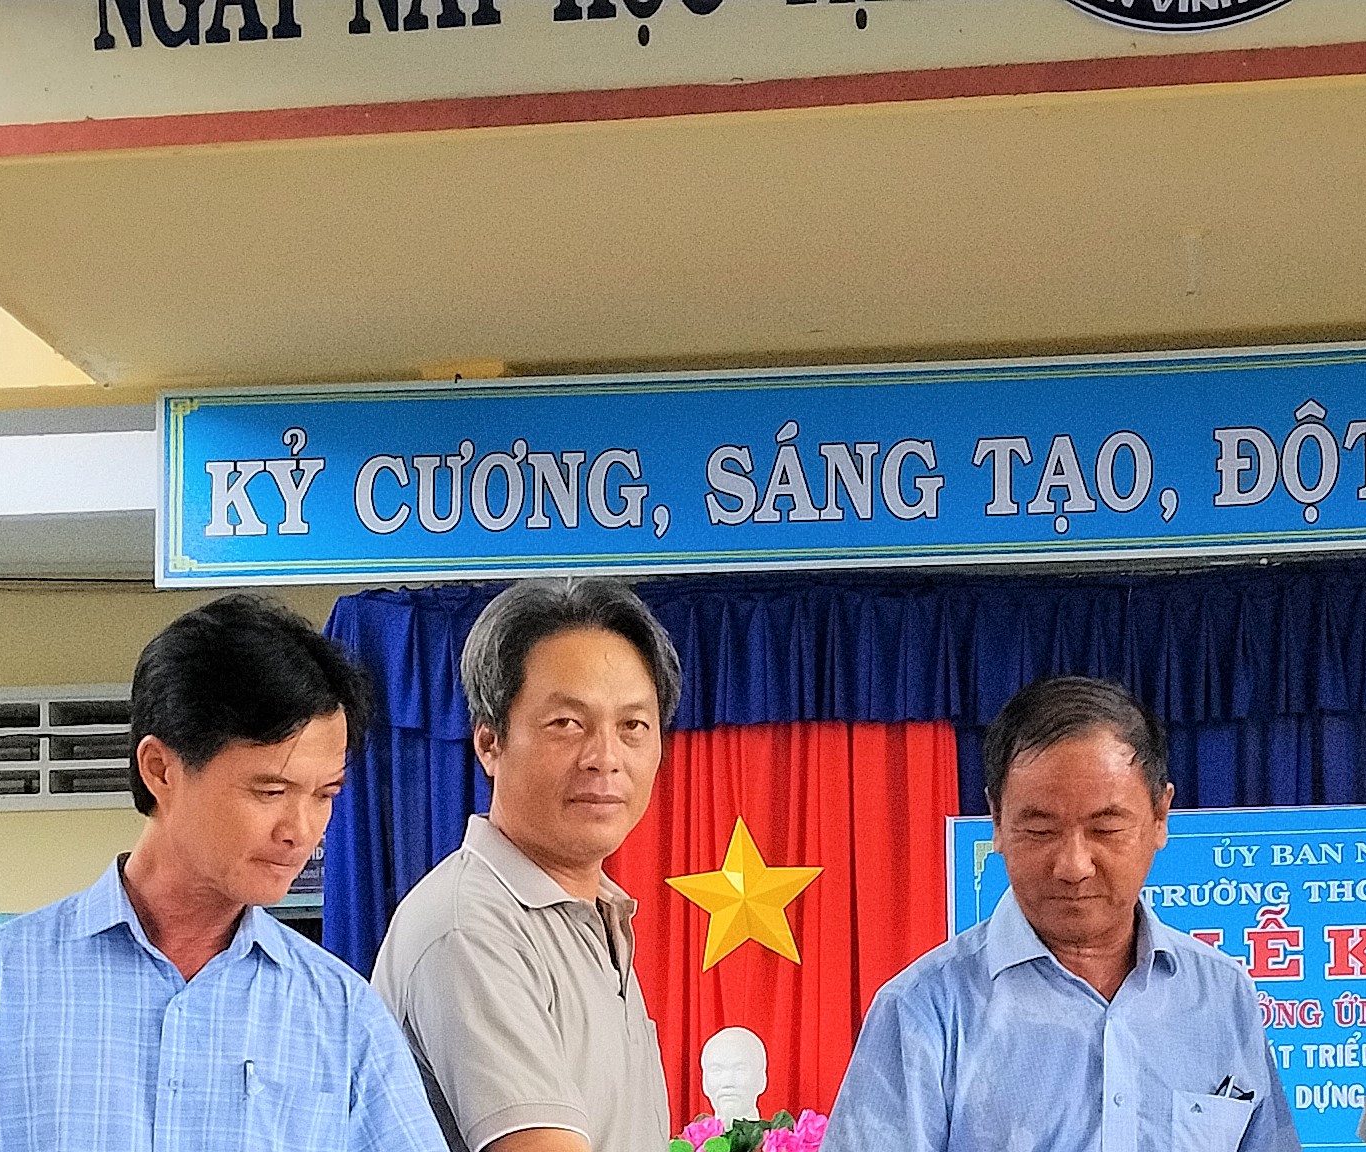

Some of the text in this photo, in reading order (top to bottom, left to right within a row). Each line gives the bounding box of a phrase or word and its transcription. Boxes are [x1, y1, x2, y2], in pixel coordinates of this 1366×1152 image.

[205, 427, 325, 537] KỶ
[354, 437, 669, 539] CƯƠNG,
[705, 421, 945, 527] SÁNG
[972, 430, 1179, 534] TẠO,
[1212, 837, 1260, 868] ỦY
[1270, 842, 1345, 867] BAN
[1140, 878, 1292, 908] TRƯỜNG
[1294, 1081, 1366, 1113] DỰNG
